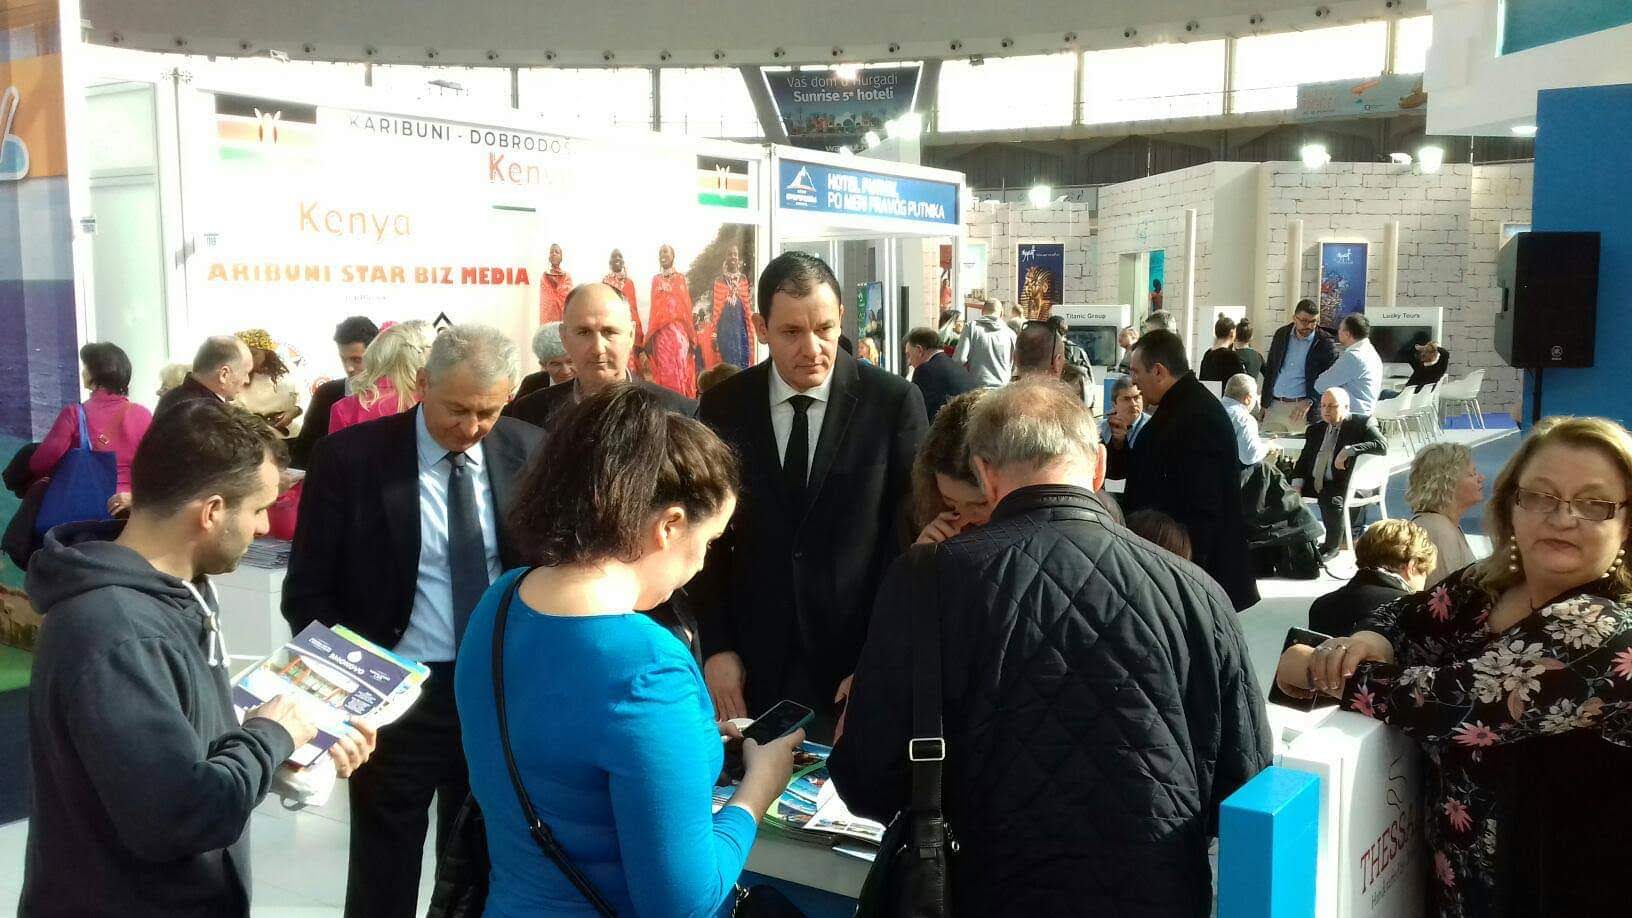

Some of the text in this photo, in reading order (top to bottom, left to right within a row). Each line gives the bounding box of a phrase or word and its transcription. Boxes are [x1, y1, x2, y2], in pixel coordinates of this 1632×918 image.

[811, 76, 838, 88] dom
[793, 89, 840, 103] Sunrise
[856, 87, 894, 101] hoteli
[350, 115, 450, 142] KARIBUNI
[827, 192, 840, 208] PO
[907, 201, 945, 219] PUTNIKA
[298, 200, 412, 242] Kenya
[341, 265, 406, 285] STAR
[414, 267, 454, 286] BIZ
[460, 267, 530, 286] MEDIA
